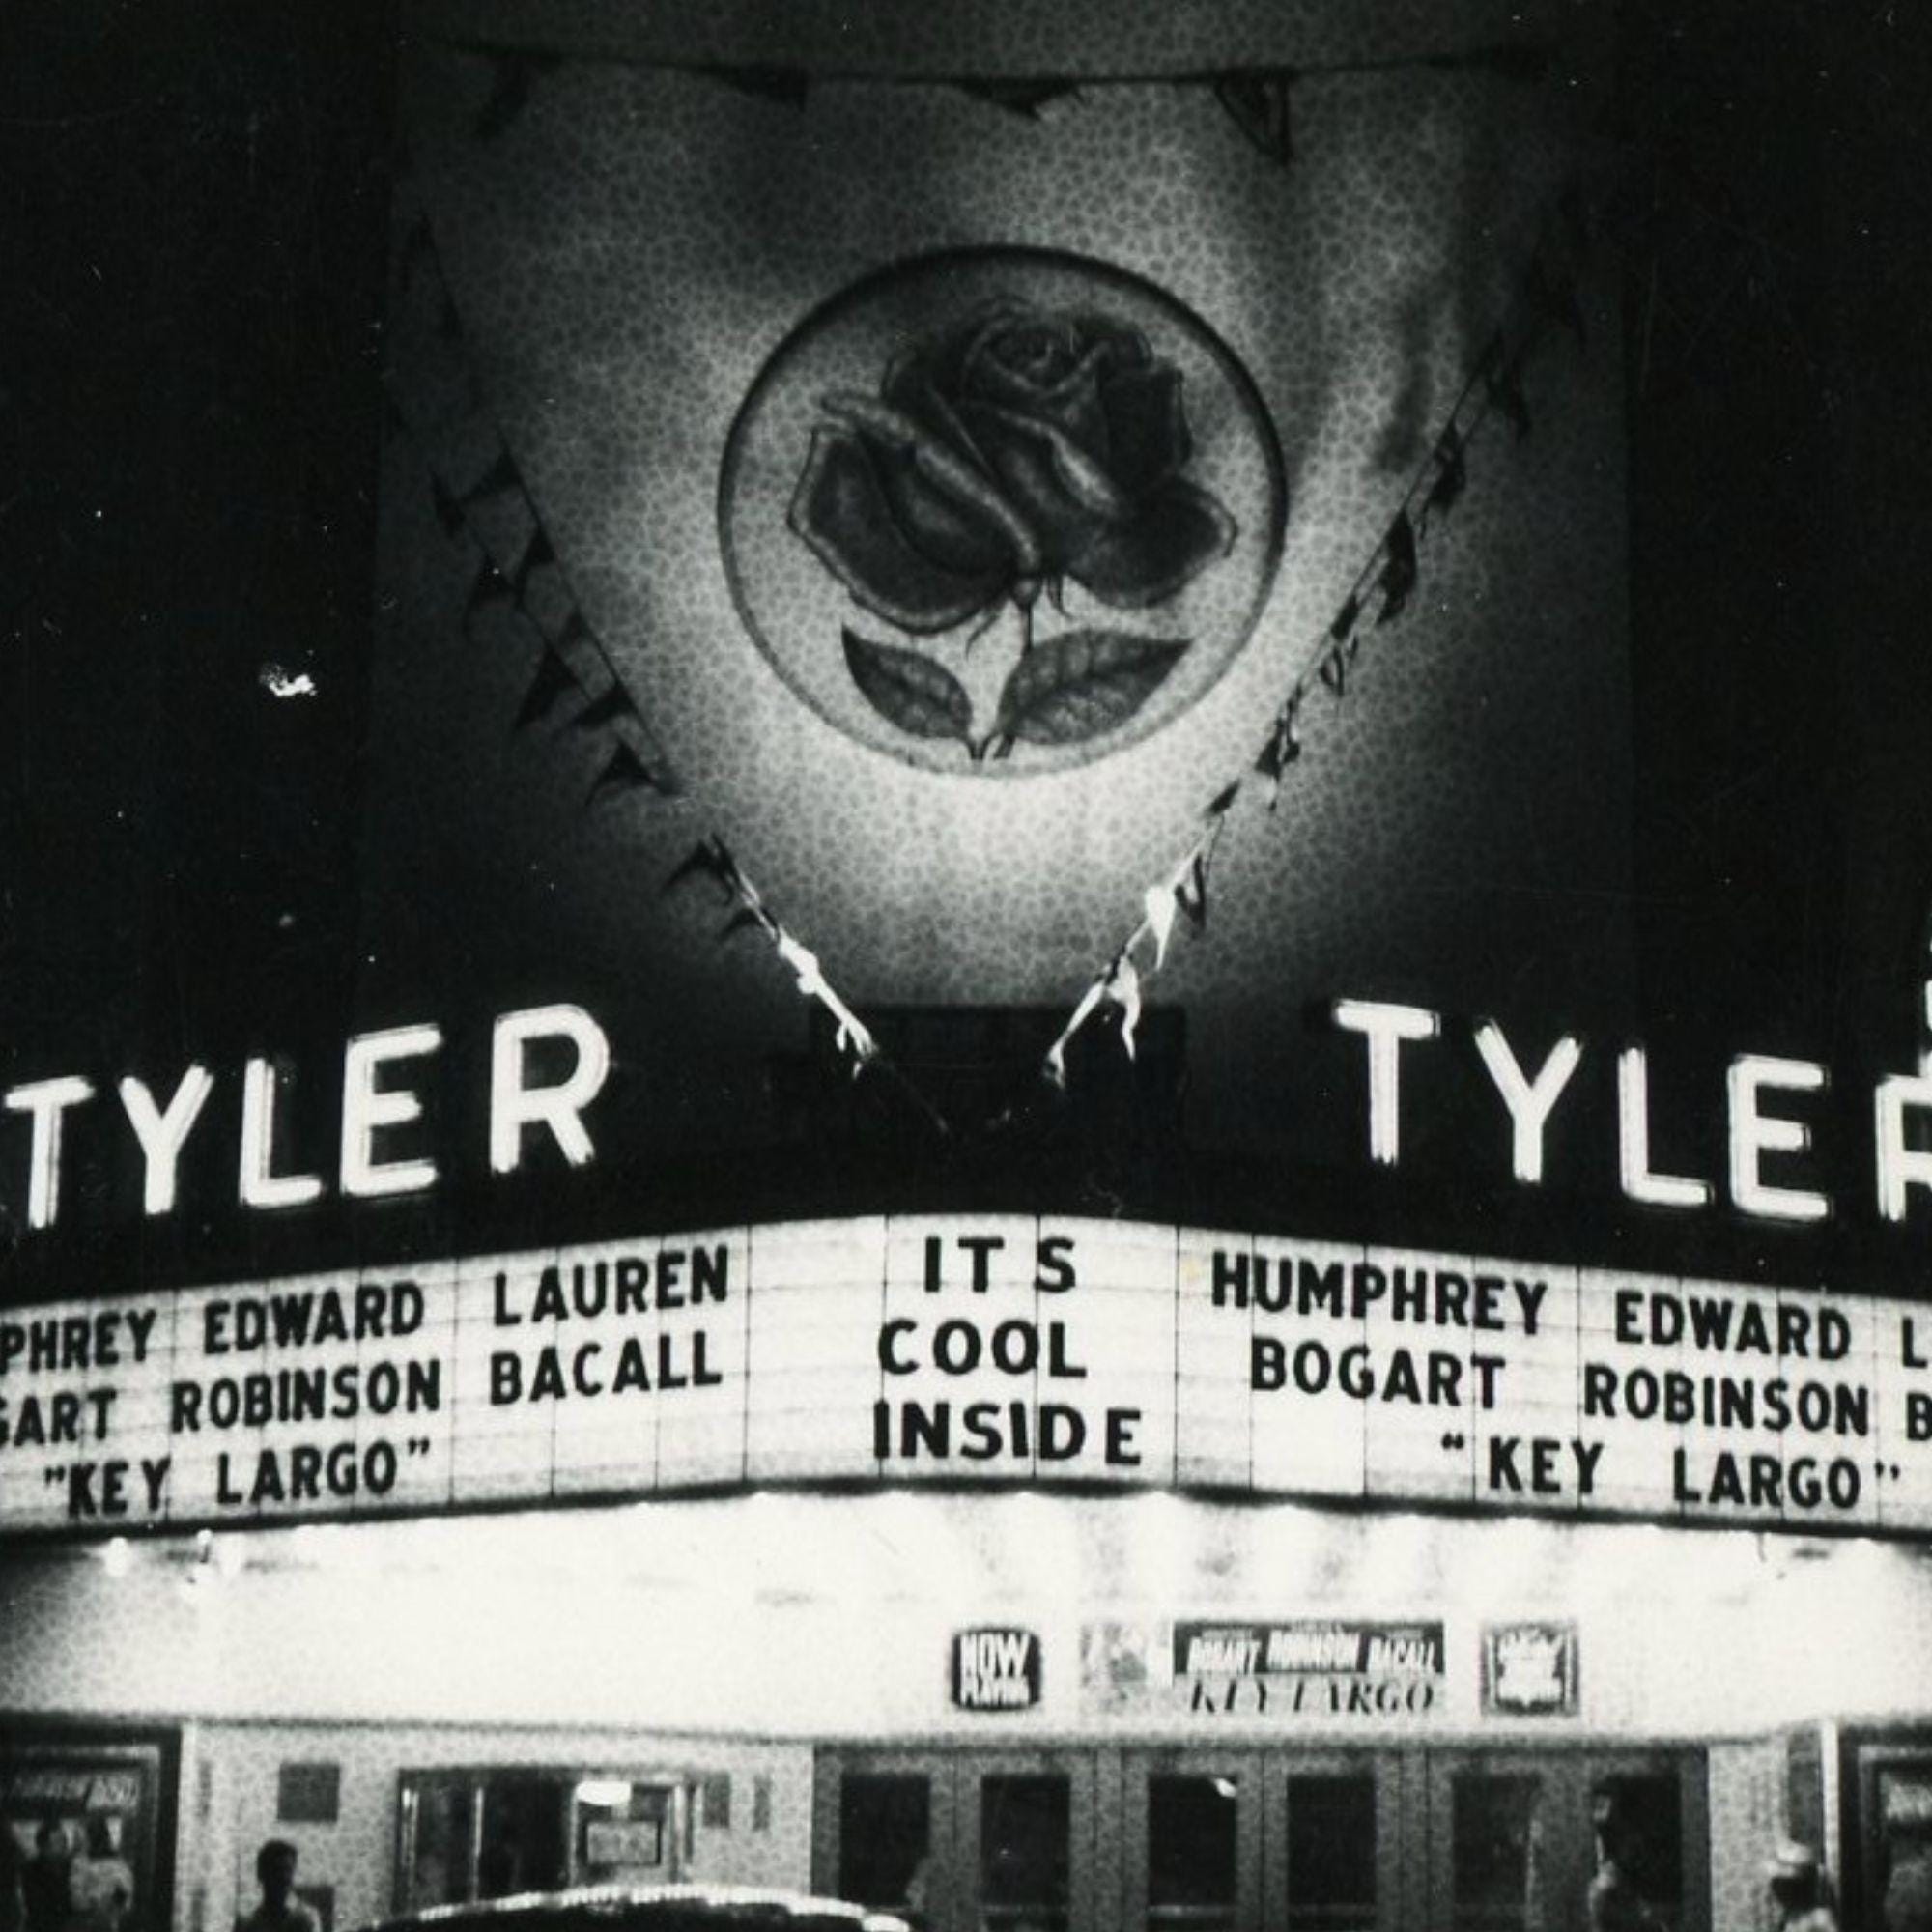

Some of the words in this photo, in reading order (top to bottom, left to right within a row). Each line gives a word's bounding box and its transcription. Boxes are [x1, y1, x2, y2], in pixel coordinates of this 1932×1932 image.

[4, 1003, 611, 1229] TYLER
[203, 1281, 425, 1355] EDWARD
[494, 1245, 729, 1328] LAUREN
[878, 1319, 1087, 1378] COOL
[1211, 1250, 1548, 1335] HUMPHREY
[1614, 1290, 1851, 1359] EDWARD
[171, 1359, 440, 1434] ROBINSON
[489, 1330, 723, 1406] BACALL
[873, 1400, 1141, 1464] INSIDE
[1250, 1336, 1506, 1409] BOGART
[1584, 1363, 1869, 1436] ROBINSON
